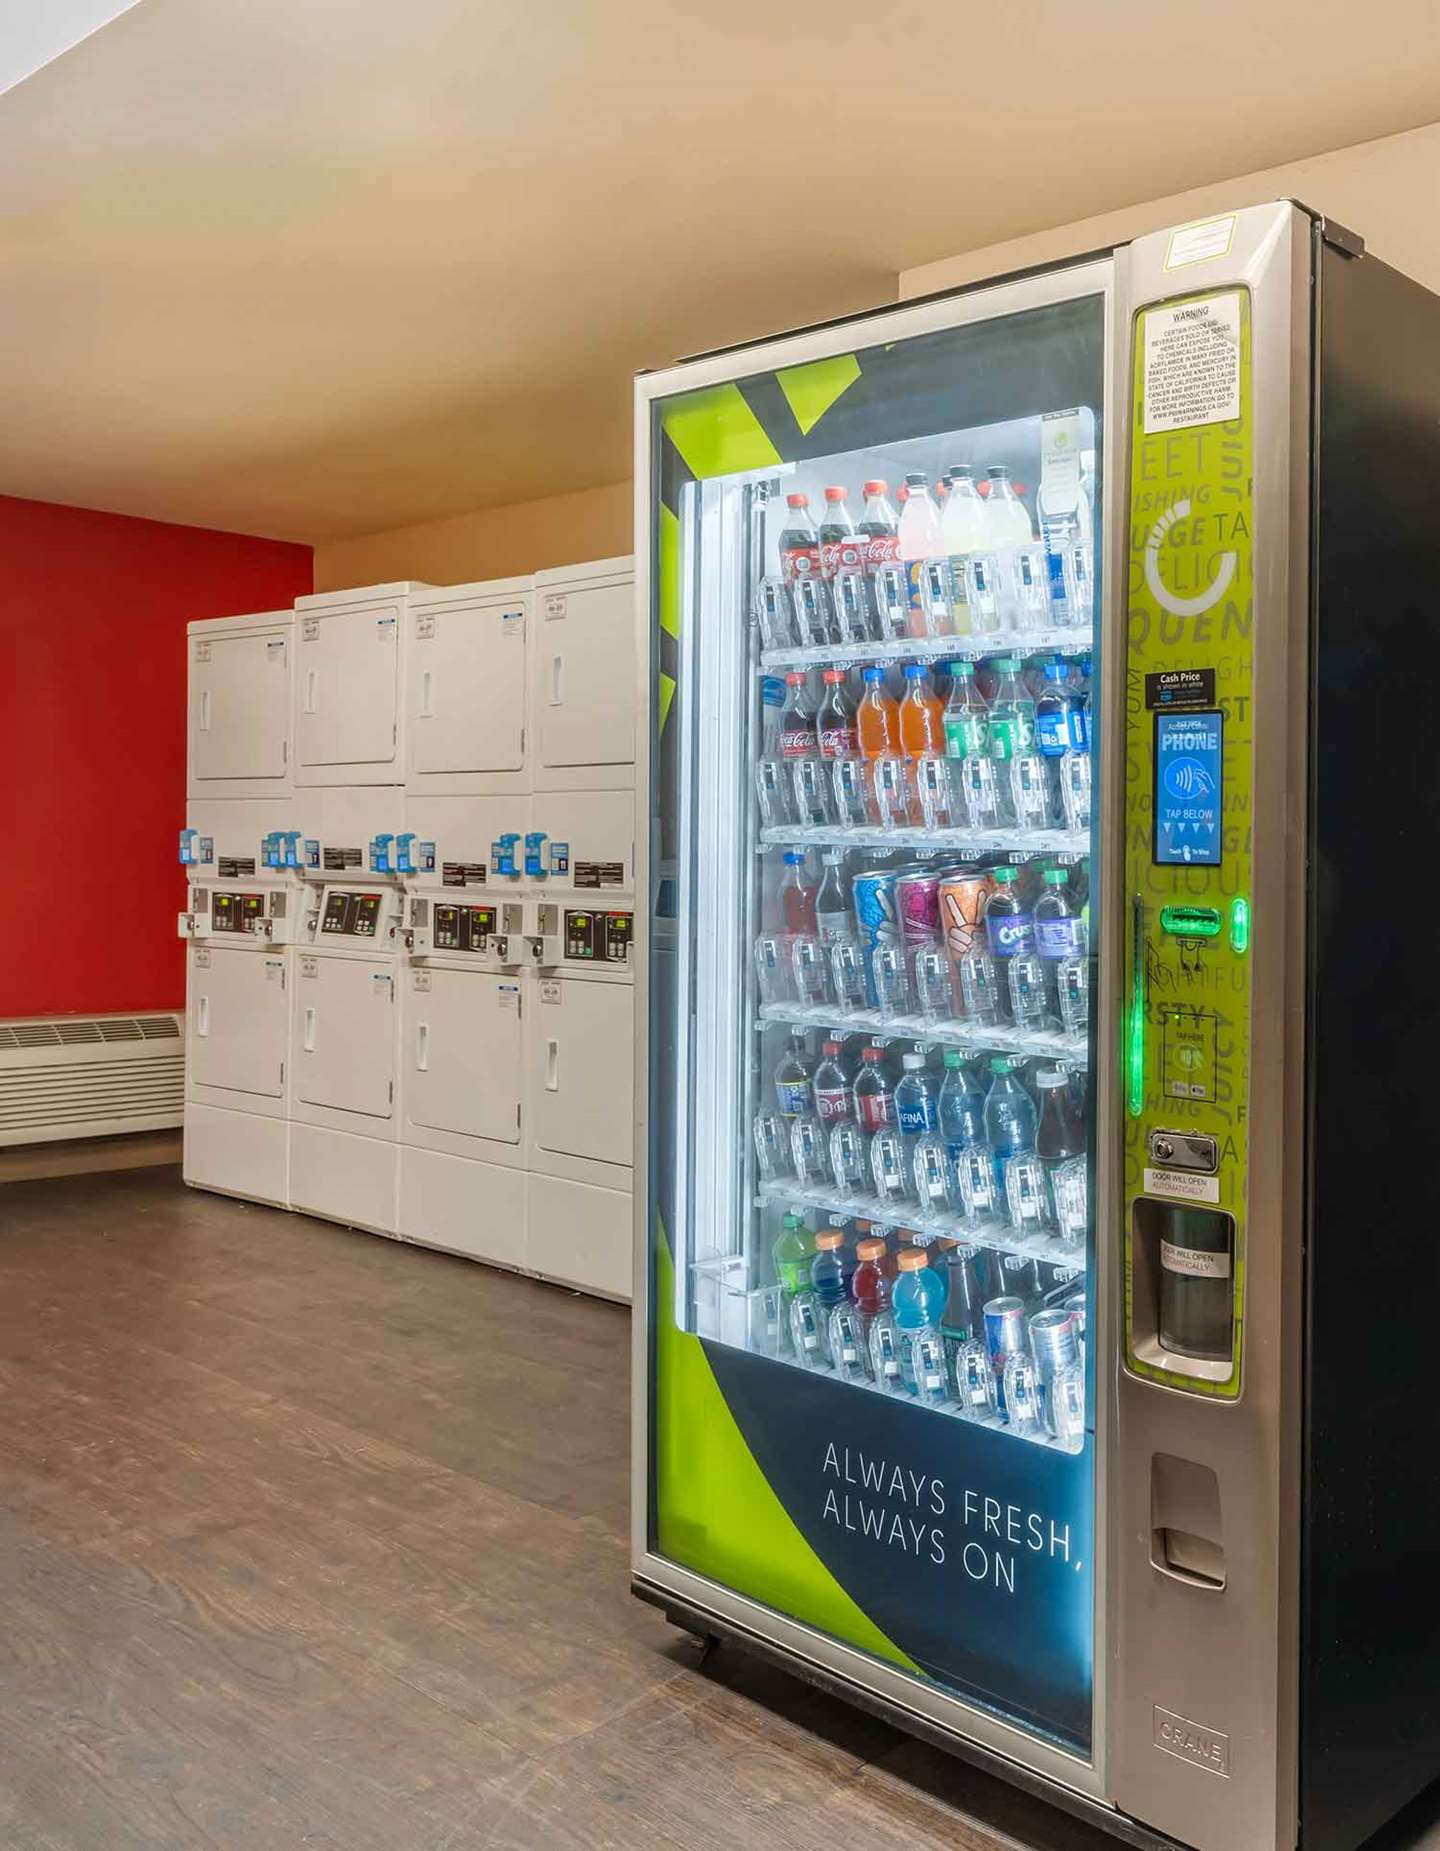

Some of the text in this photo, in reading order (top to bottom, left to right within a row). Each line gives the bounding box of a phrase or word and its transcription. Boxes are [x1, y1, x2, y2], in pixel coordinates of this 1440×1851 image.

[1172, 305, 1209, 322] WARNING
[1160, 671, 1200, 684] Cash Price
[1161, 731, 1217, 751] PHONE
[1165, 808, 1213, 819] TAP BELOW
[1152, 1180, 1205, 1194] AUTOMATICALLY
[1188, 1175, 1208, 1186] OPEN
[823, 1441, 1082, 1571] ALWAYS FRESH,
[823, 1488, 1015, 1593] ALWAYS ON
[1160, 1720, 1223, 1763] CRANE
